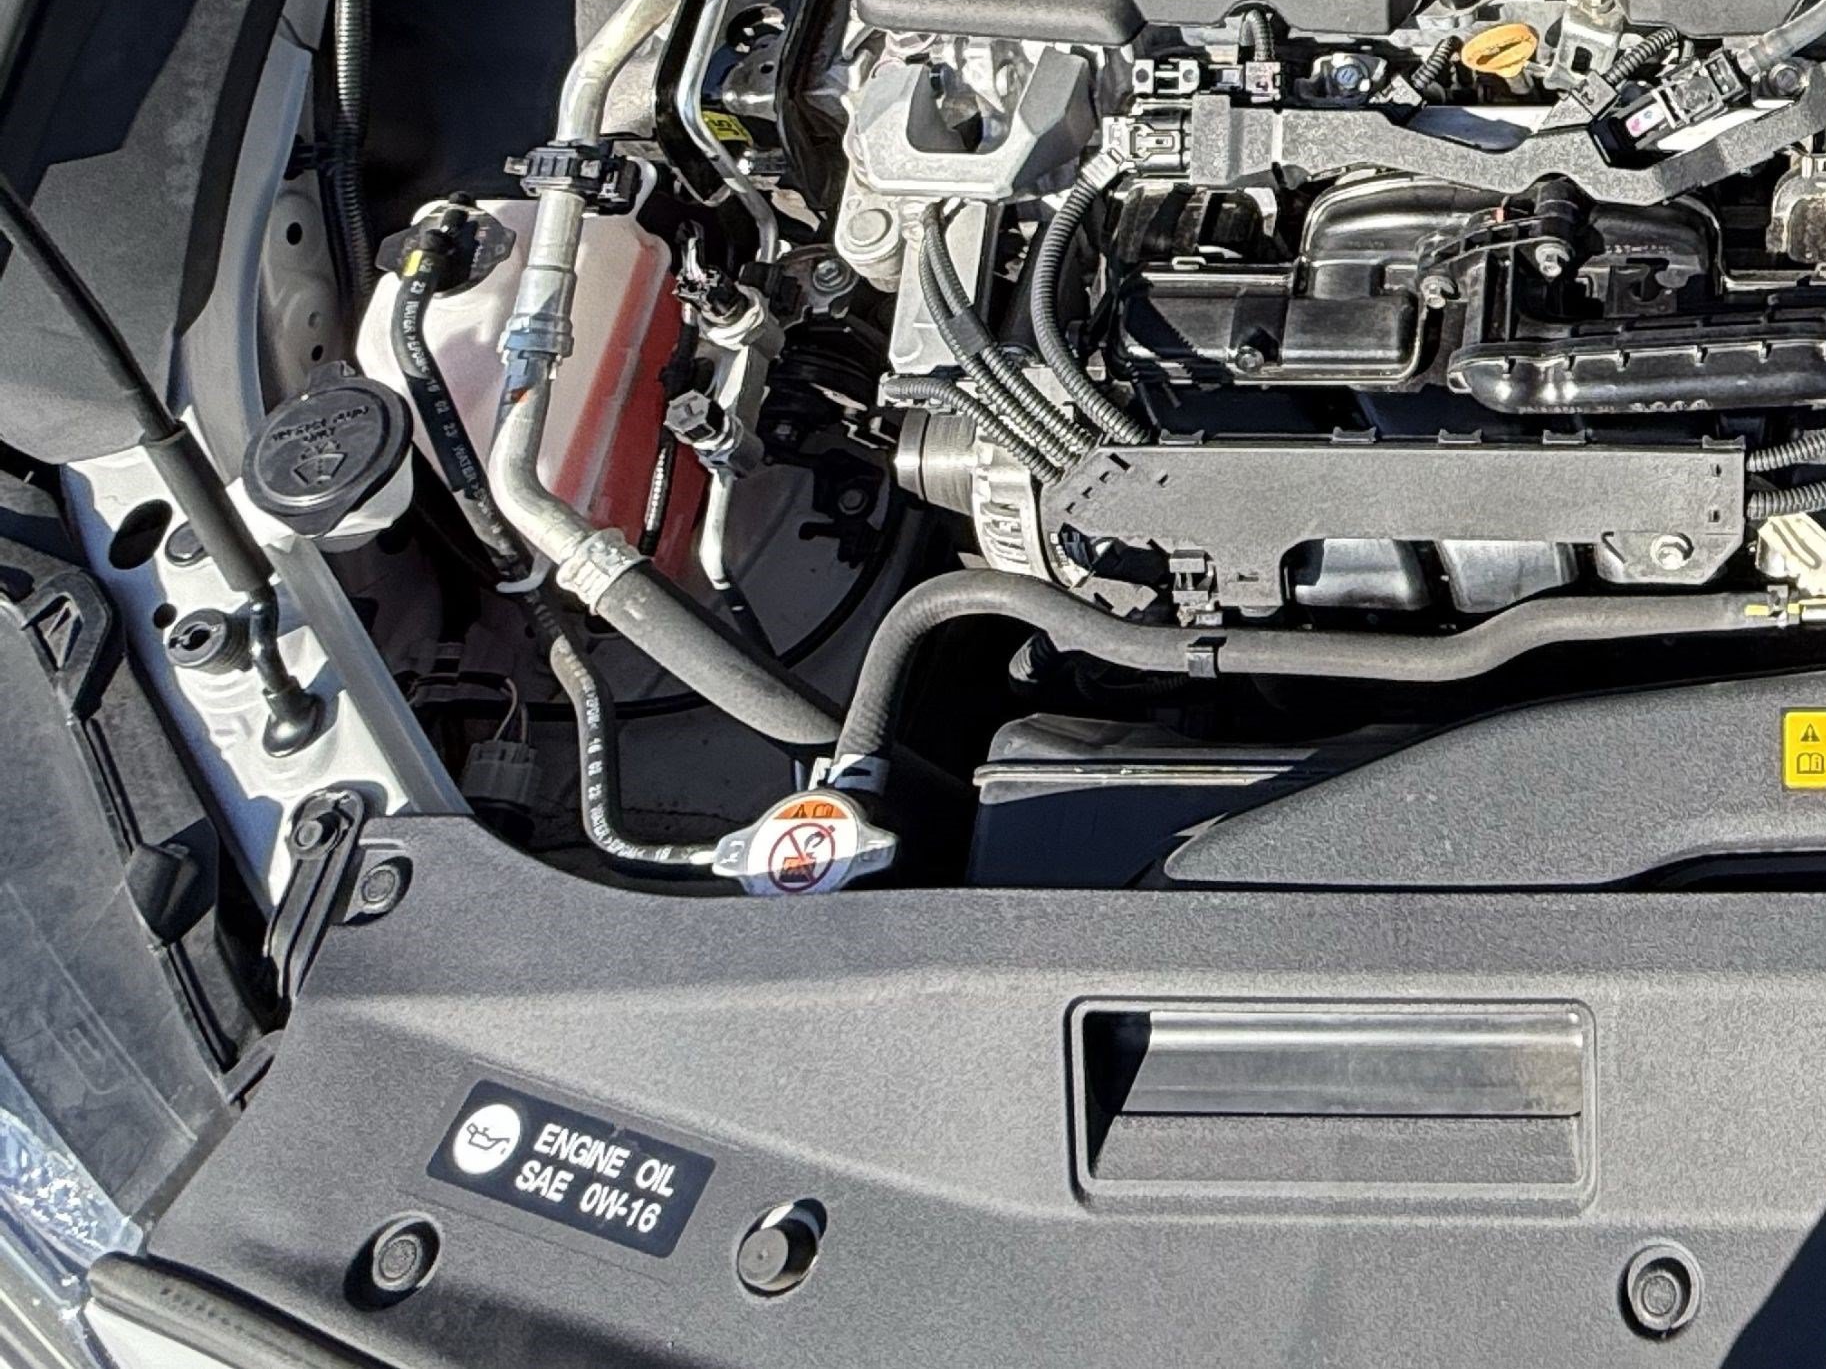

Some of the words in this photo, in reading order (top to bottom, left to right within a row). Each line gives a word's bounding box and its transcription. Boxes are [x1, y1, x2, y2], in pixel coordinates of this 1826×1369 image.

[514, 1159, 575, 1203] SAE
[579, 1182, 662, 1233] 0W-16
[533, 1123, 631, 1179] ENGINE
[635, 1159, 676, 1198] OIL
